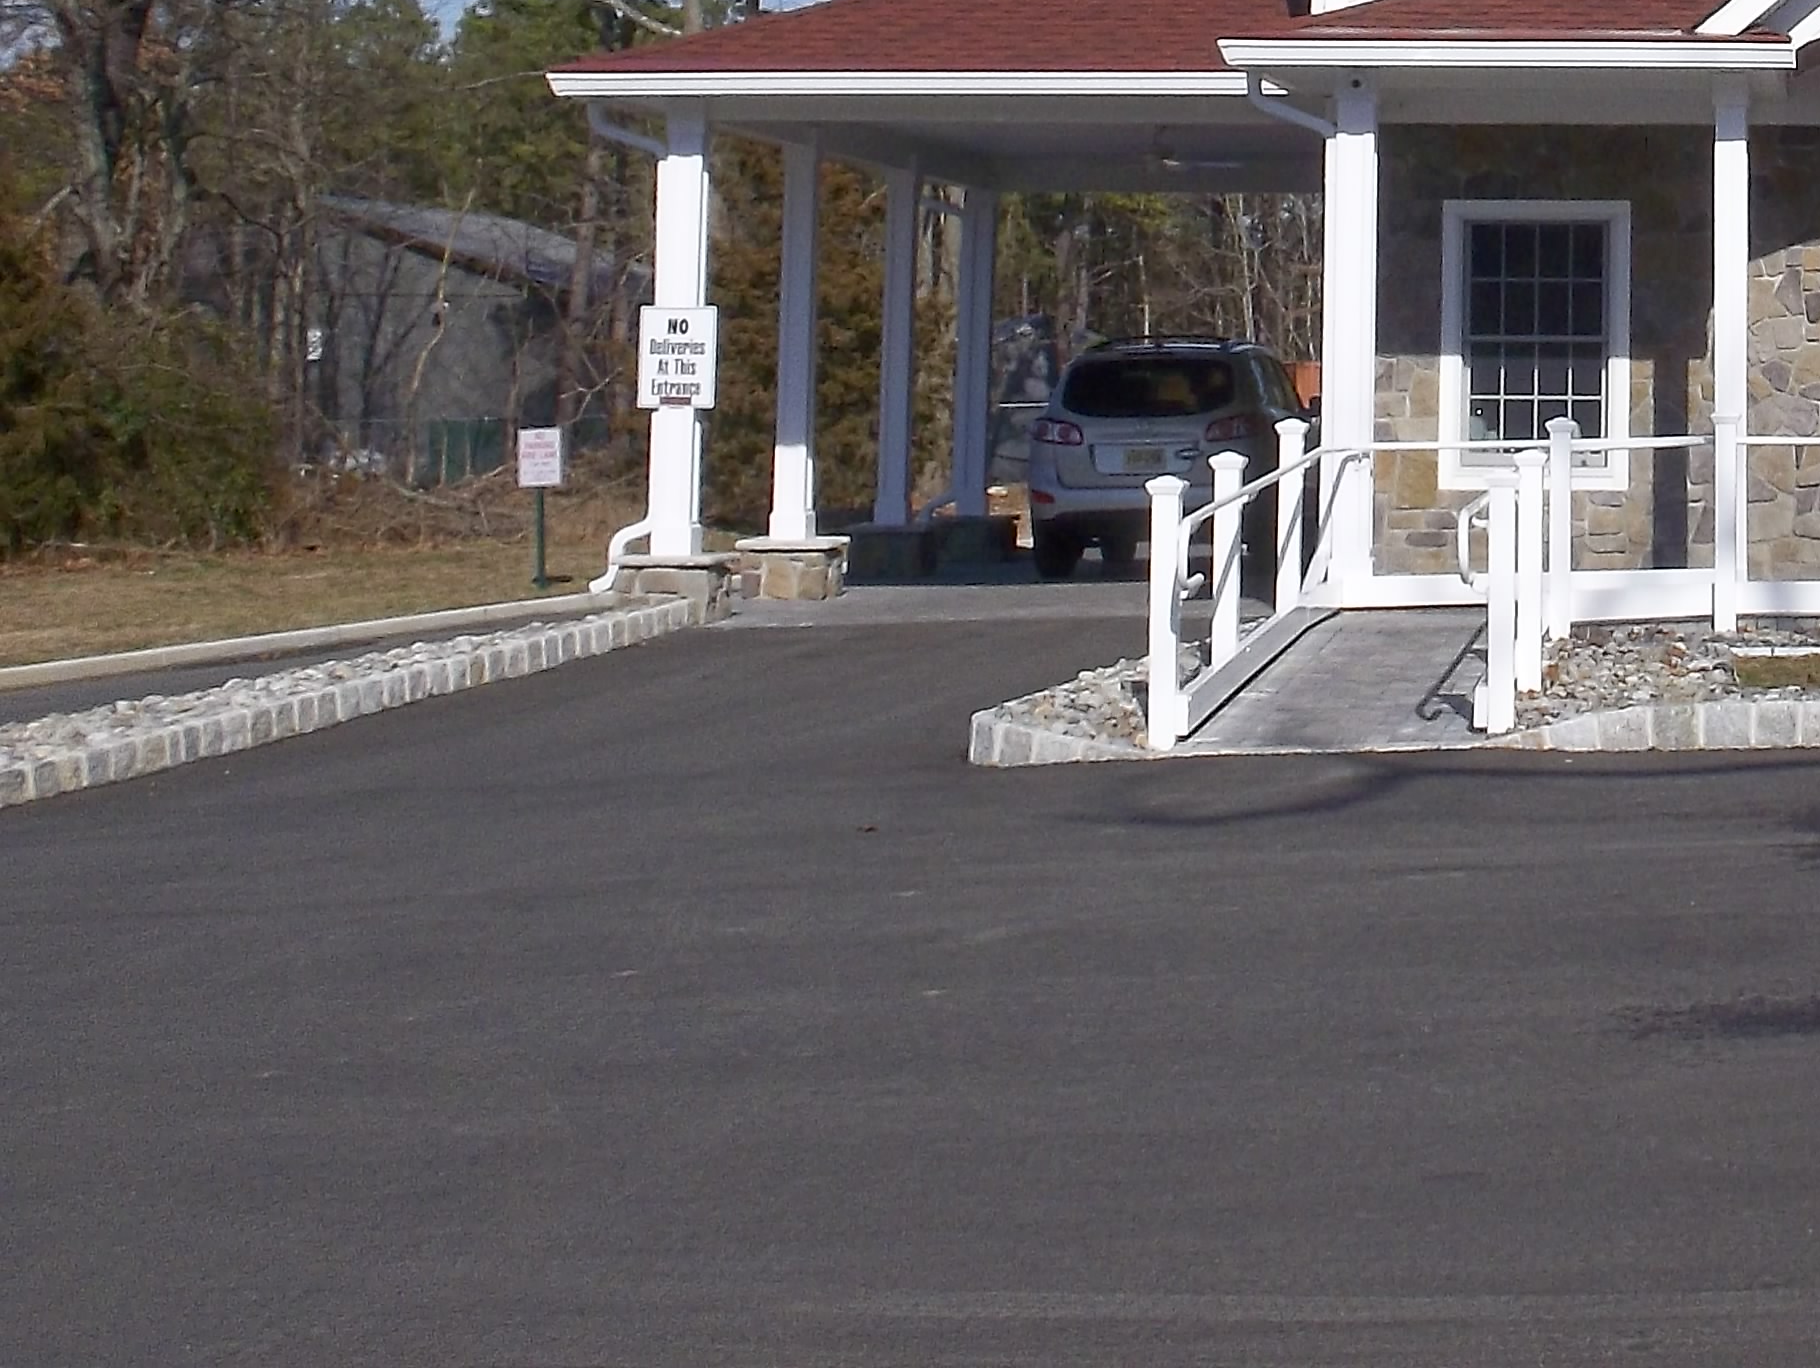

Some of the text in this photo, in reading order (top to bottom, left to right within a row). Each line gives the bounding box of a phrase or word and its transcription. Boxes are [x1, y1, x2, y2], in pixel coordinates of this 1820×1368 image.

[667, 318, 689, 335] NO
[650, 338, 706, 355] Deliveries
[657, 358, 696, 375] At This
[651, 378, 701, 396] Entrance
